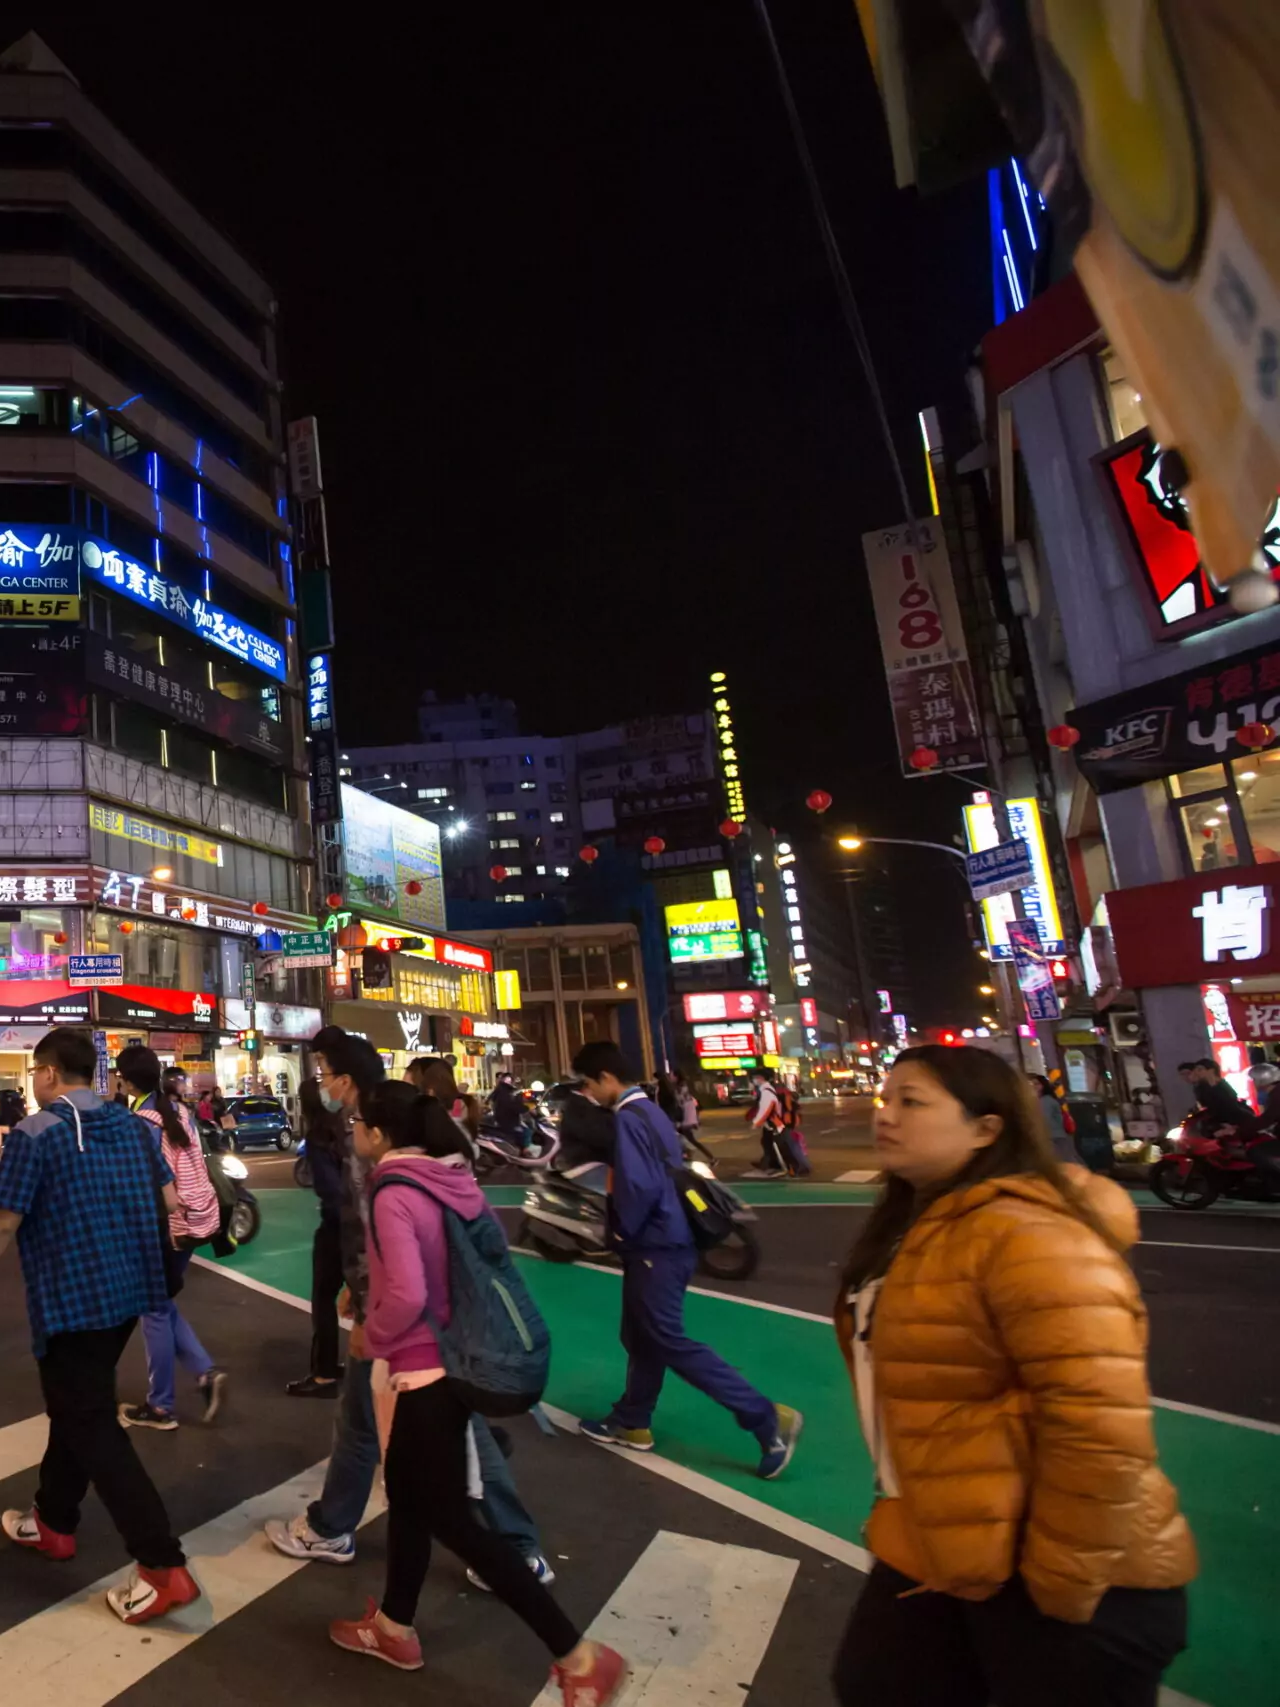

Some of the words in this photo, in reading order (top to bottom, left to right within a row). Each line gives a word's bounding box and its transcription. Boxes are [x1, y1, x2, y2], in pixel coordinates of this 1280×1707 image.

[22, 577, 69, 589] CENTER
[1105, 714, 1159, 746] KFC
[1192, 885, 1268, 963] 肯
[288, 933, 323, 945] 中正路
